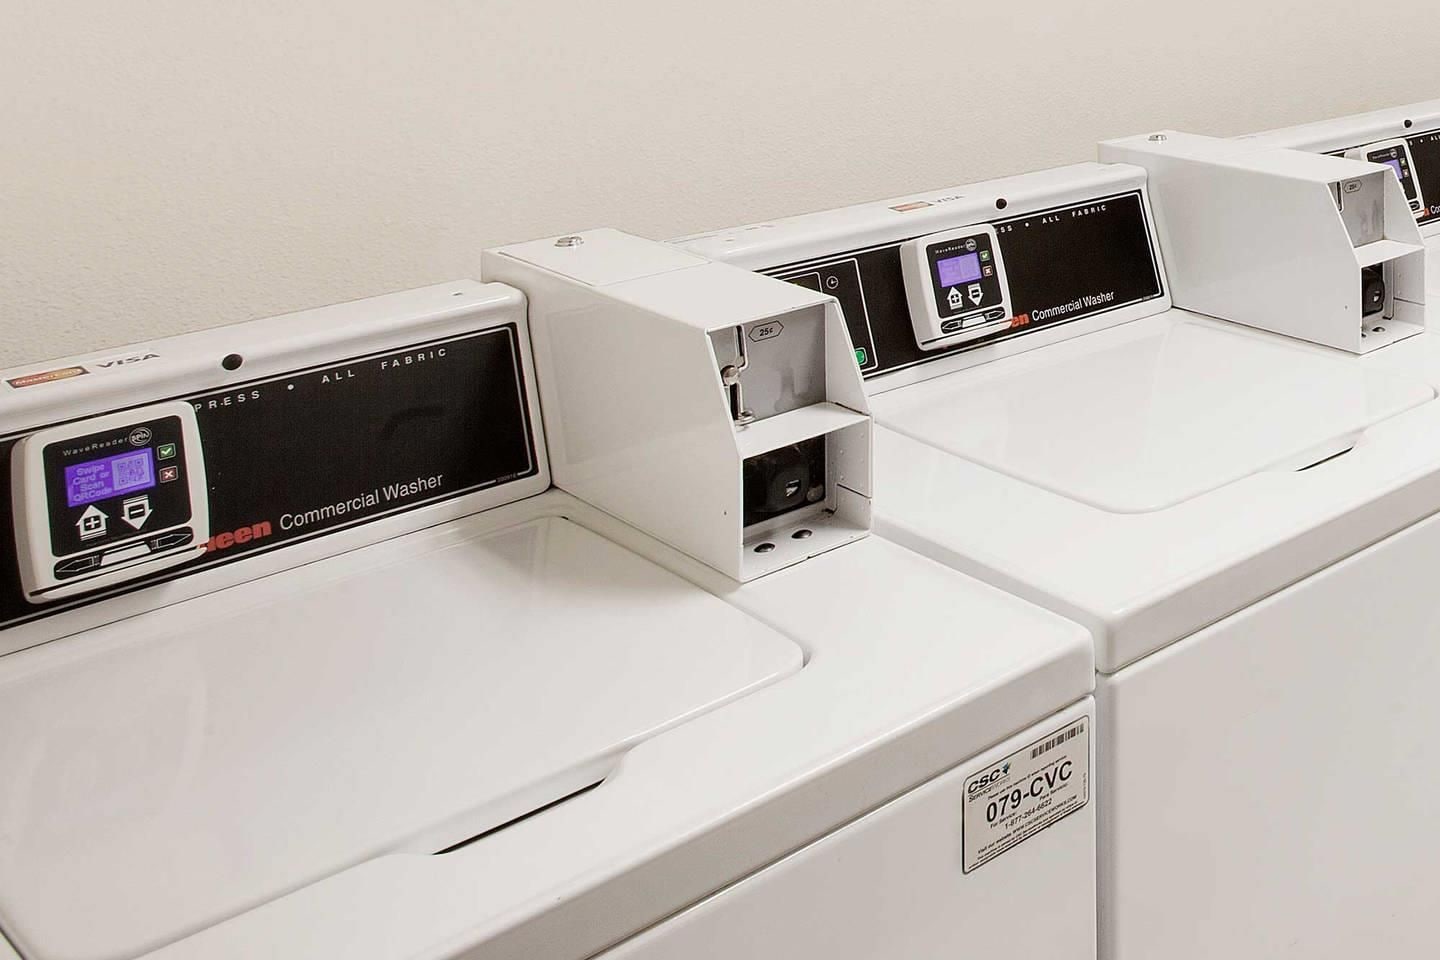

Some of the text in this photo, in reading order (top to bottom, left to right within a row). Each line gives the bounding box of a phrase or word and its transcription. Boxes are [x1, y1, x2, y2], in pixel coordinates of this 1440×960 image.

[1042, 204, 1107, 224] ALL FABRIC
[1031, 299, 1083, 322] Commercial
[1083, 291, 1115, 308] Washer
[321, 370, 356, 384] ALL
[381, 348, 447, 370] FABRIC
[62, 436, 129, 456] WaveReader
[72, 474, 96, 485] Card
[76, 464, 105, 476] Swipe
[79, 481, 104, 491] Scan
[279, 489, 380, 531] Commercial
[382, 474, 443, 502] Washer
[967, 768, 1000, 794] CSC
[986, 760, 1072, 823] 079-CVC
